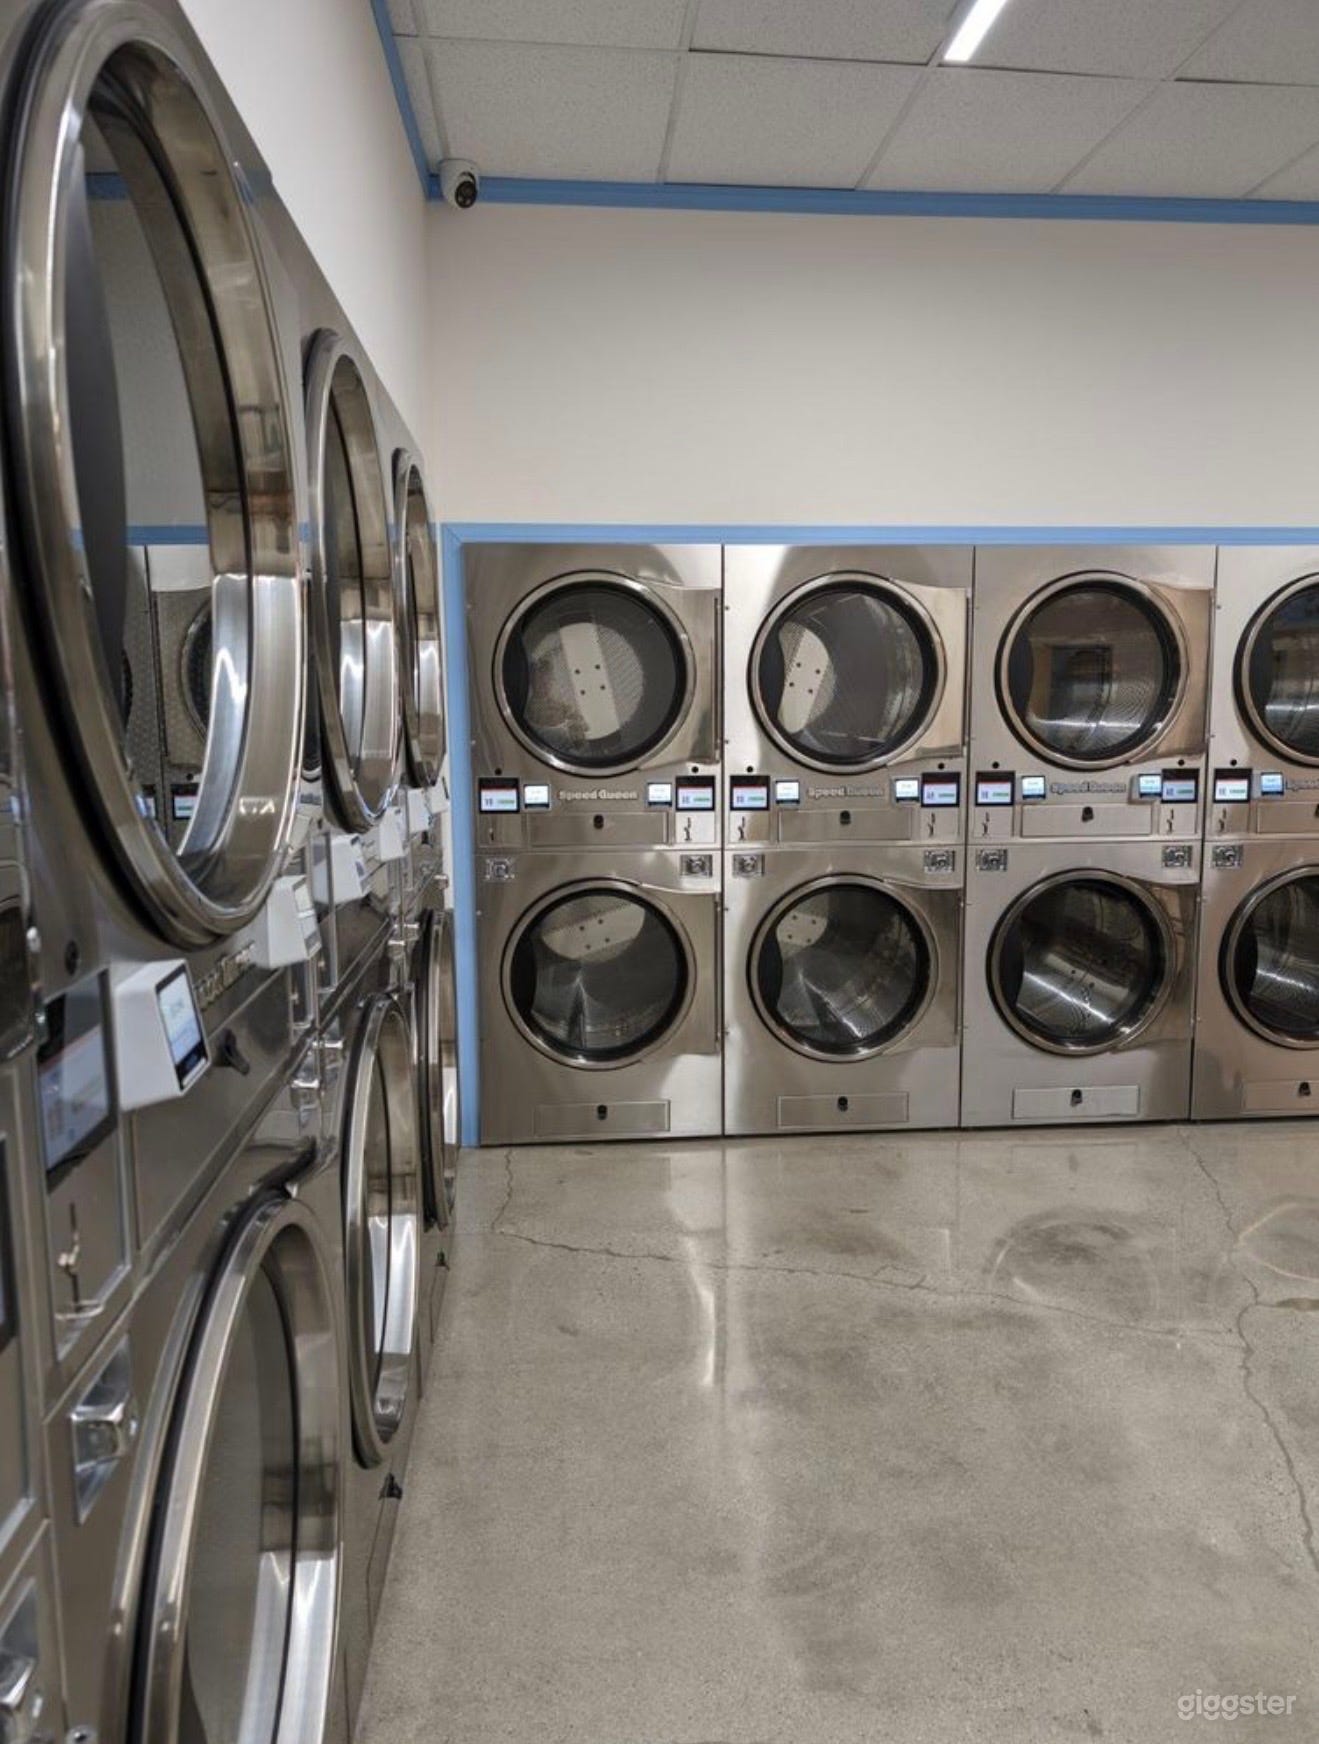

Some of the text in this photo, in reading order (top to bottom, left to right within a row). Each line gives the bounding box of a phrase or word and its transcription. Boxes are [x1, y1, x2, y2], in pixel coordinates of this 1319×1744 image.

[558, 788, 638, 801] Speed Queen
[807, 786, 845, 799] Speed
